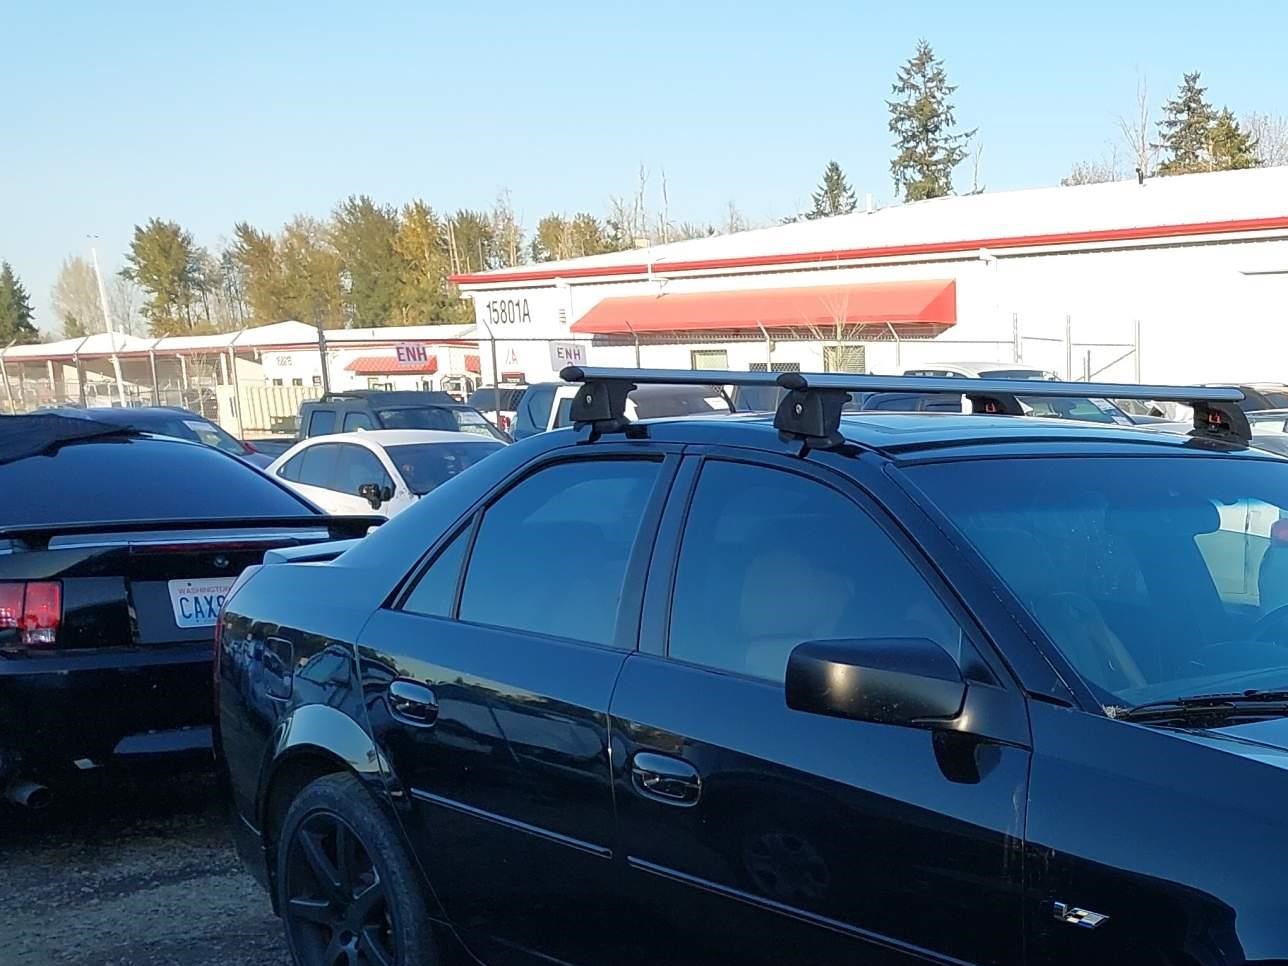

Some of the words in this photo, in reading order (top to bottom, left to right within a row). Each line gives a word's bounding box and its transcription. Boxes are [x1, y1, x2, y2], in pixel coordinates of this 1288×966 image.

[486, 298, 531, 324] 15801A
[396, 346, 428, 362] ENH
[556, 347, 581, 361] ENH
